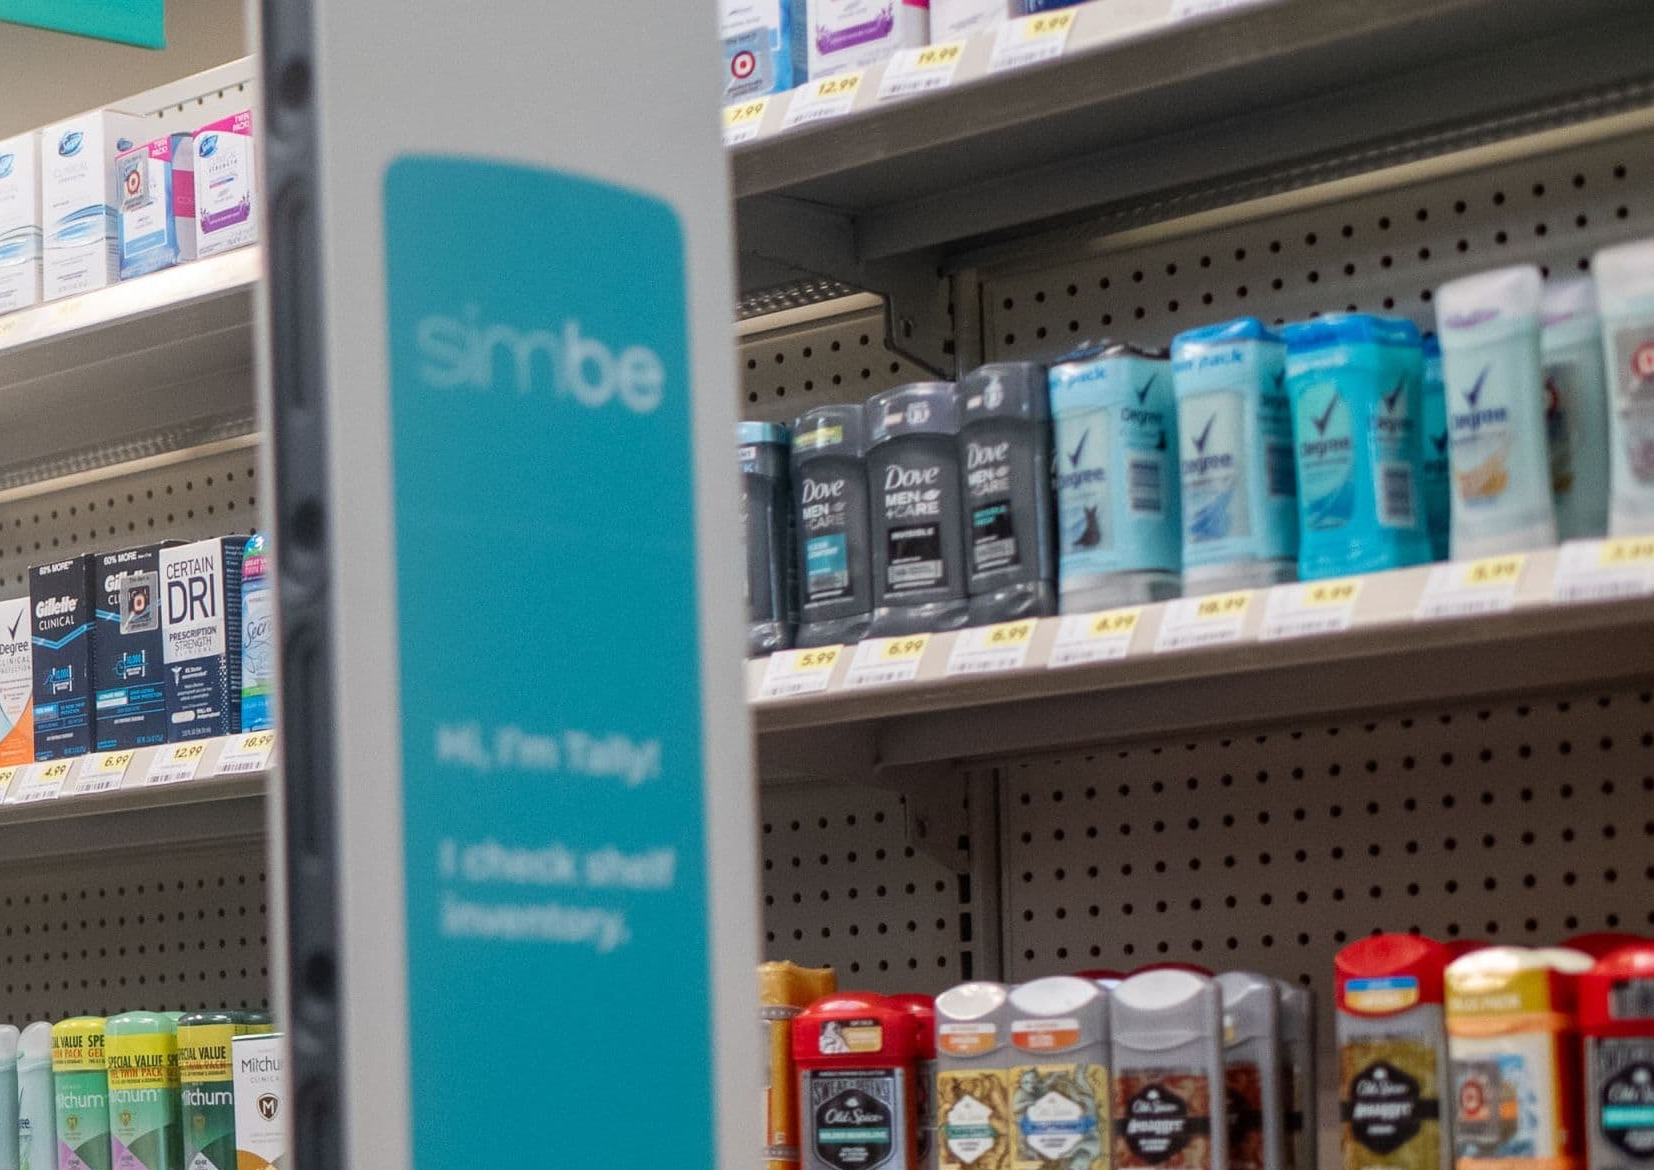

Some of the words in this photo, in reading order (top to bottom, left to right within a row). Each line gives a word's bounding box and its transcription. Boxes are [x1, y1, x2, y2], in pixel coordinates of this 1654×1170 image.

[416, 303, 665, 414] simbe
[967, 442, 1010, 469] Dove
[885, 464, 940, 491] Dove
[802, 478, 845, 504] Dove
[886, 490, 919, 507] MEN
[803, 503, 829, 520] MEN
[118, 551, 137, 561] MORE
[166, 556, 214, 580] CERTAIN
[36, 596, 78, 618] Gillette
[168, 574, 216, 625] DRI
[39, 615, 75, 631] CLINICAL
[169, 626, 217, 642] PRESCRIPTION
[0, 641, 28, 656] Degree
[174, 636, 212, 651] STRENGTH
[802, 651, 835, 667] 5.99
[174, 745, 203, 759] 12.99
[564, 729, 660, 787] Tally!
[104, 754, 129, 768] 6.99
[462, 838, 576, 885] check
[584, 845, 675, 888] shelf
[61, 1036, 83, 1048] VALUE
[199, 1046, 226, 1059] VALUE
[108, 1055, 131, 1068] SPECIAL
[134, 1054, 163, 1067] VALUE
[241, 1057, 283, 1073] Mitchu
[141, 1068, 163, 1077] PACK
[250, 1076, 281, 1084] CLINICA
[825, 1109, 850, 1124] Old
[851, 1108, 883, 1125] Spice
